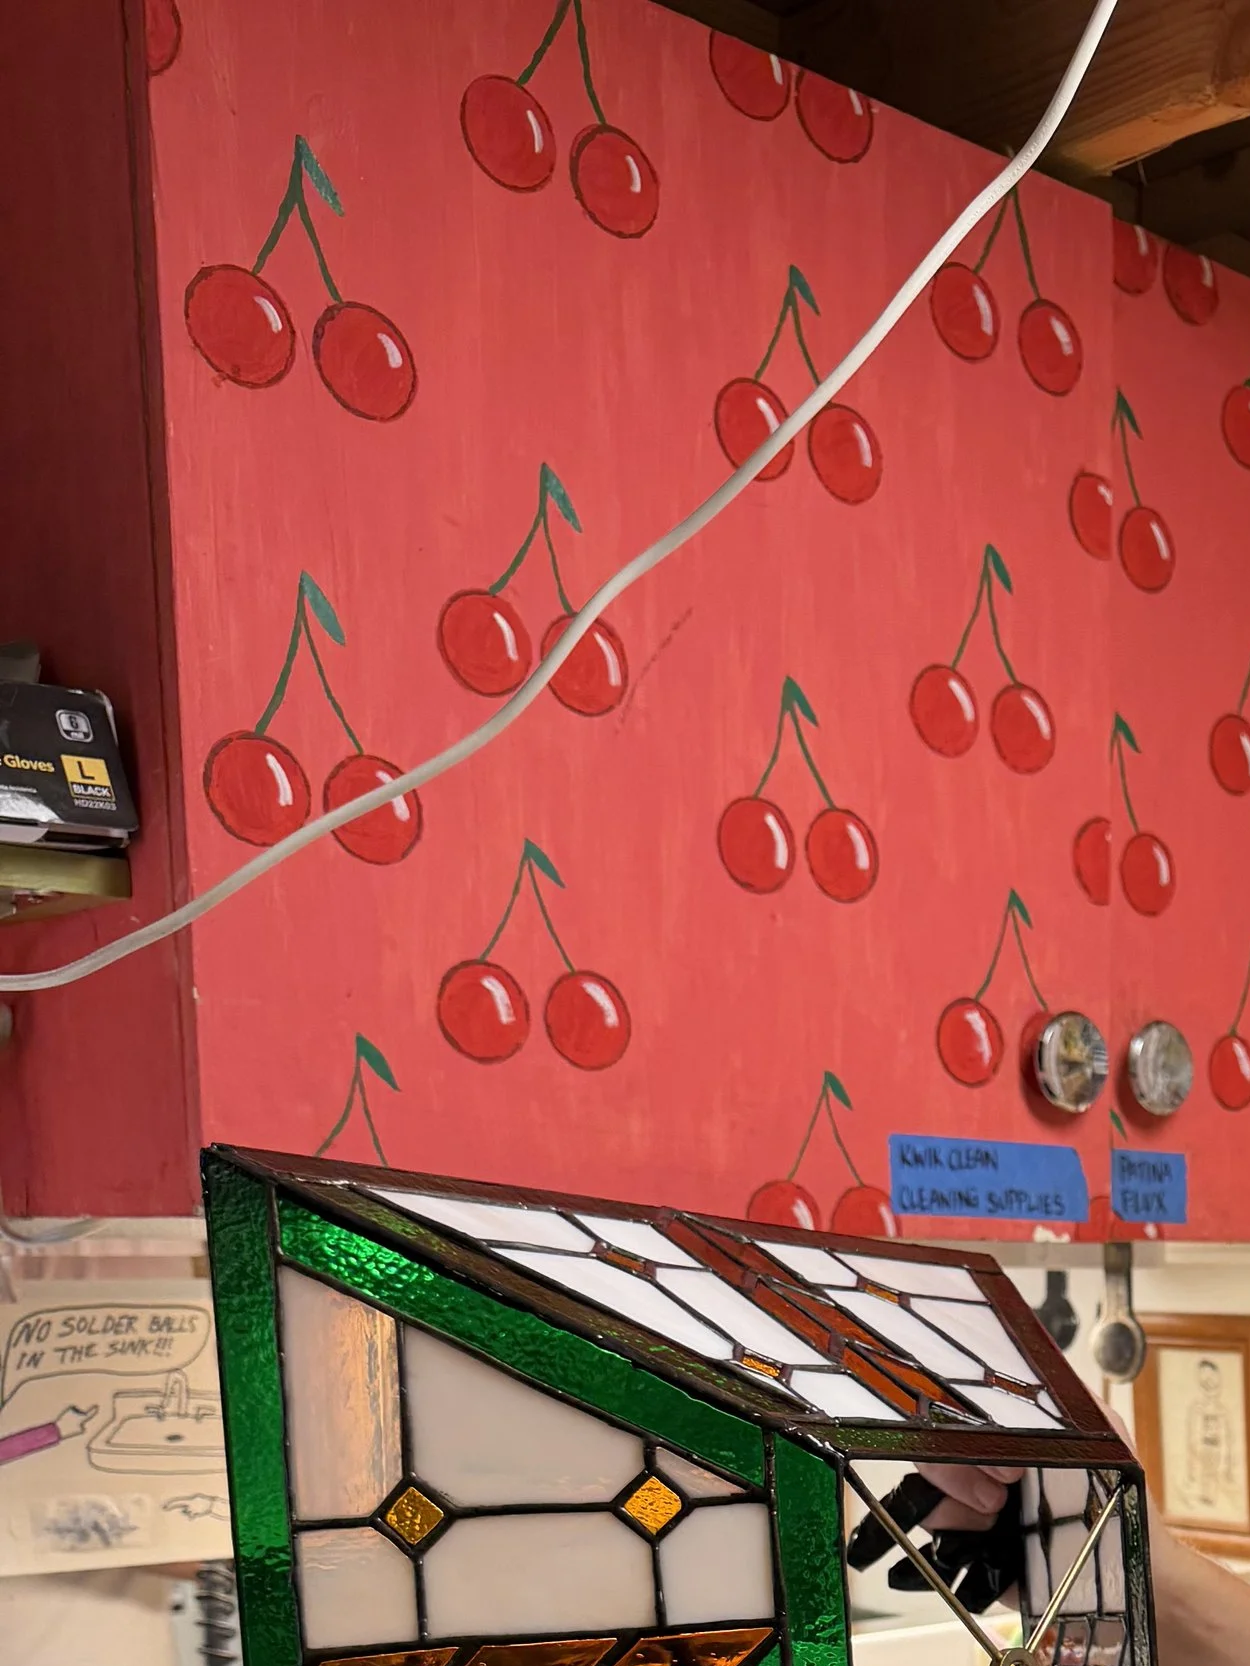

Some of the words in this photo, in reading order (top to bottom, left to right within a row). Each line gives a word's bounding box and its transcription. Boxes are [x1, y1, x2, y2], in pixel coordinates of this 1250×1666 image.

[3, 754, 55, 772] Gloves
[77, 760, 96, 781] L
[72, 784, 112, 797] BLACK
[900, 1144, 942, 1168] KWIK
[949, 1148, 999, 1171] CLEAN
[1119, 1155, 1173, 1184] PATINA
[901, 1186, 980, 1211] CLEANING
[987, 1188, 1066, 1216] SUPPLIES
[1121, 1190, 1168, 1214] FLUX
[13, 1318, 51, 1348] NO
[58, 1314, 138, 1337] SOLDER
[148, 1313, 200, 1334] BALLS
[17, 1351, 45, 1370] IN
[54, 1343, 99, 1364] THE
